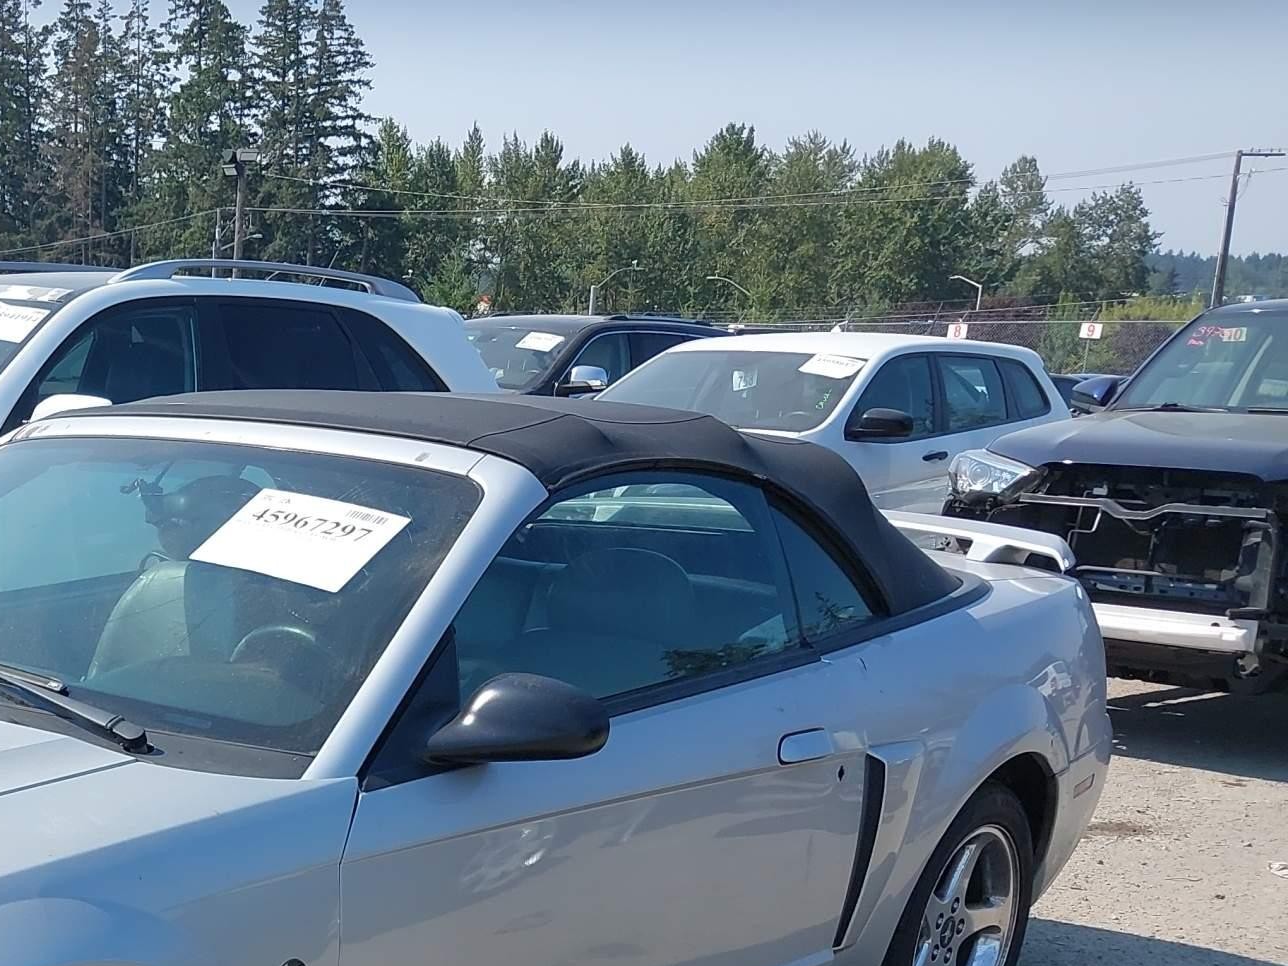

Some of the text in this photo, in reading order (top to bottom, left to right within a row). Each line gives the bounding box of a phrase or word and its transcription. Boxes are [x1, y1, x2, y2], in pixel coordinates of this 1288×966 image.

[953, 325, 962, 338] 8
[1086, 323, 1096, 337] 9
[252, 507, 374, 543] 45967297
